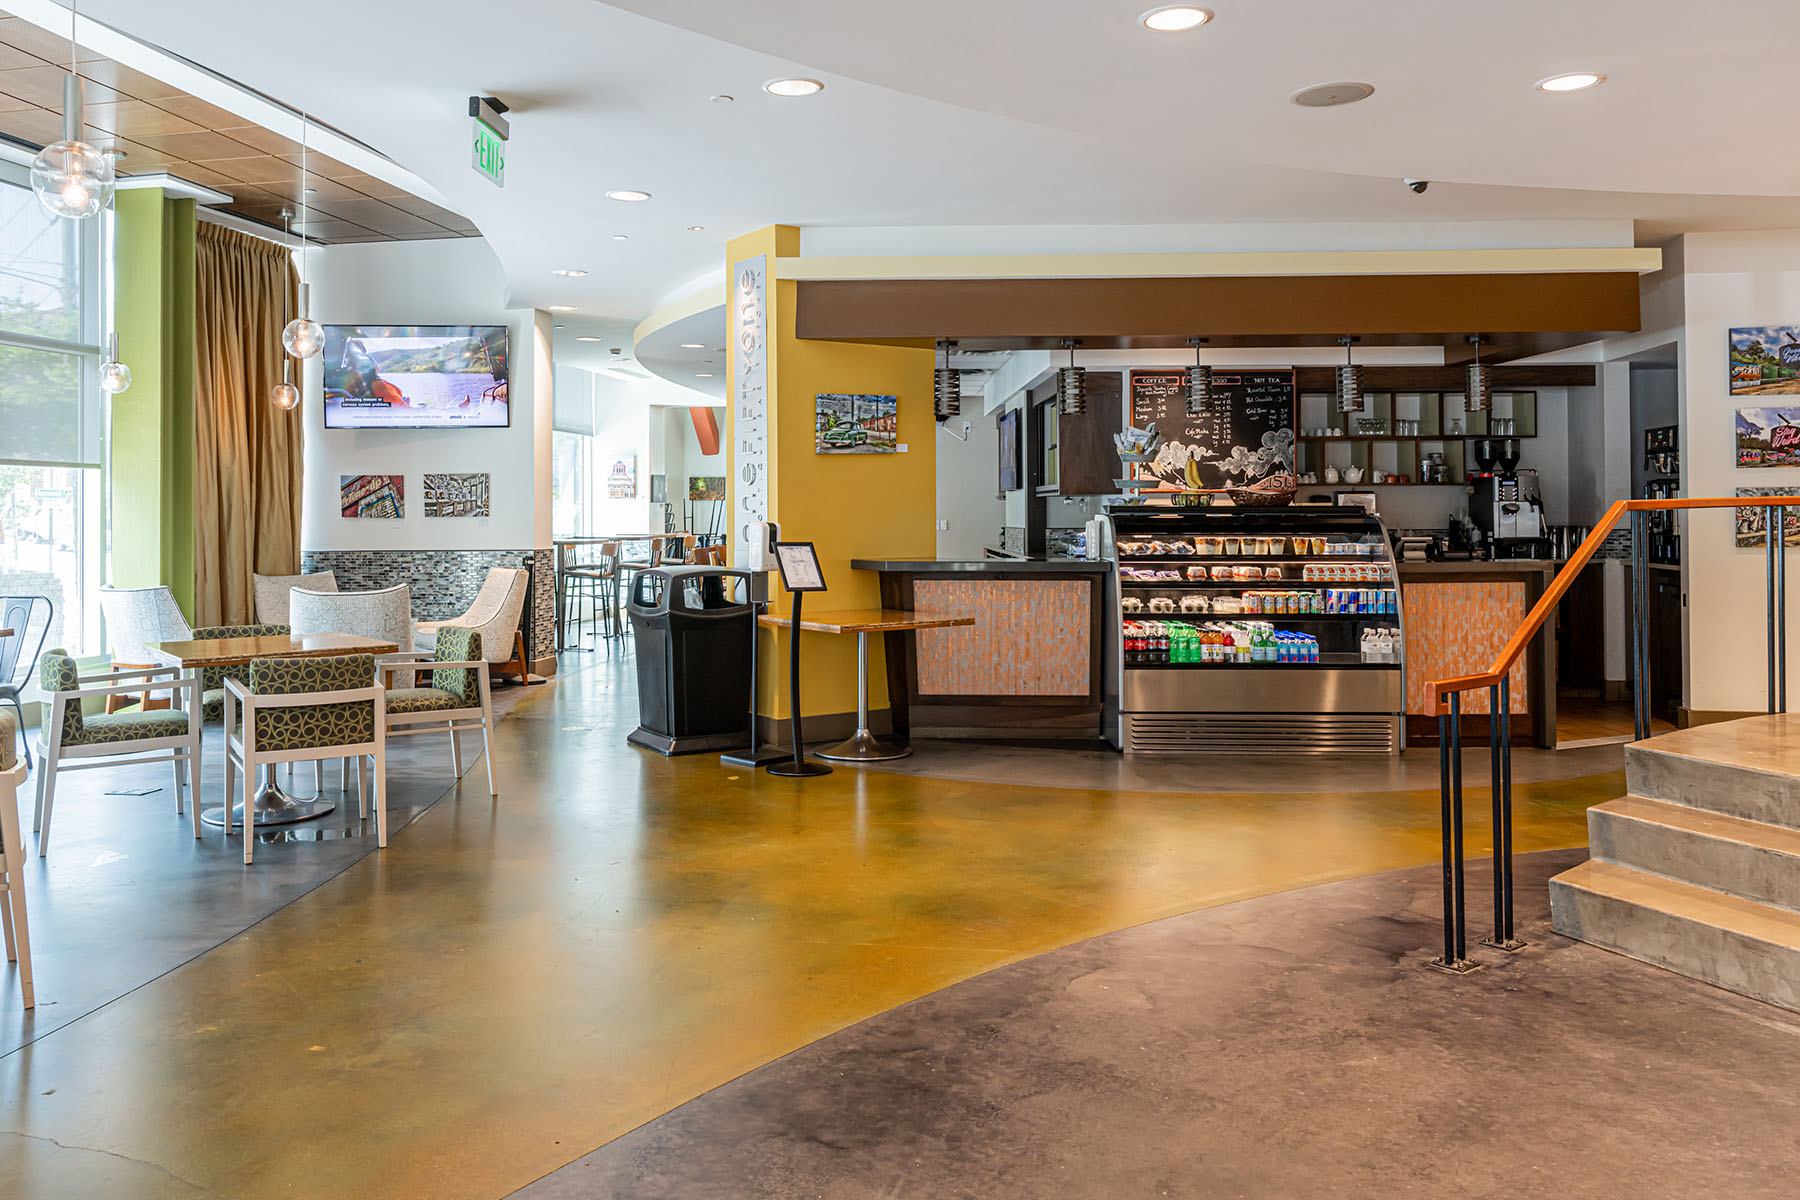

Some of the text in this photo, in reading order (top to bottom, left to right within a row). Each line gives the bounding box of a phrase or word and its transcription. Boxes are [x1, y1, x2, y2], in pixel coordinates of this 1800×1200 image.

[480, 129, 500, 178] EXIT
[1775, 426, 1796, 437] Stay
[1772, 434, 1800, 448] Weird
